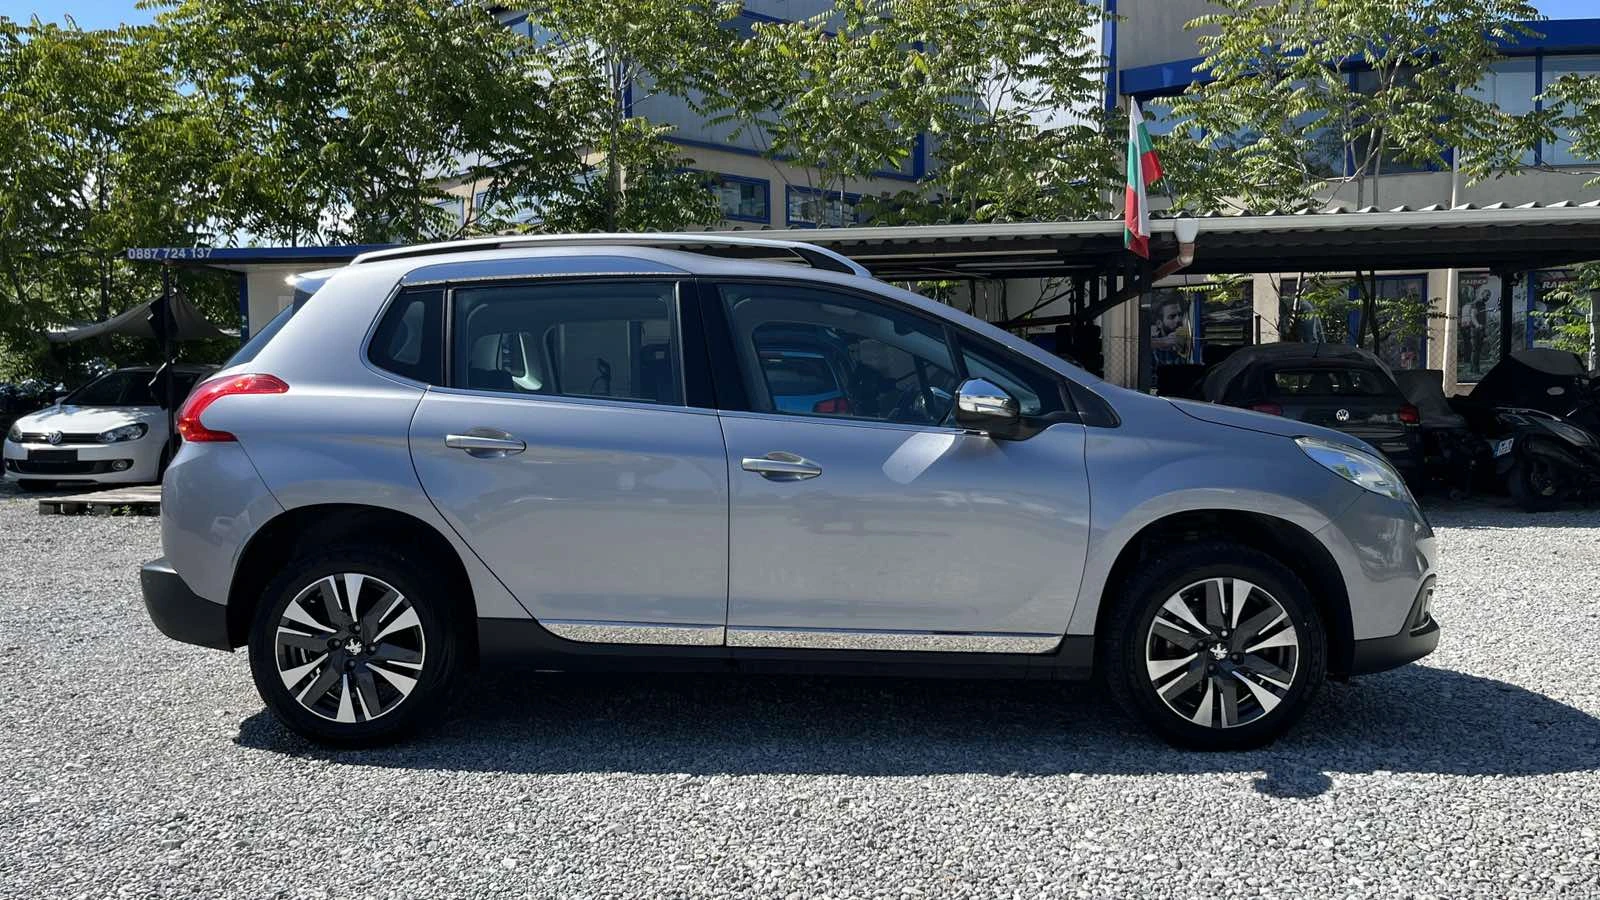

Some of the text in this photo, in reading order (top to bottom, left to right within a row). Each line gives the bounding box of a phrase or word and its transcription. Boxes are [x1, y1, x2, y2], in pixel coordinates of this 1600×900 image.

[128, 248, 212, 259] 0887 724 137
